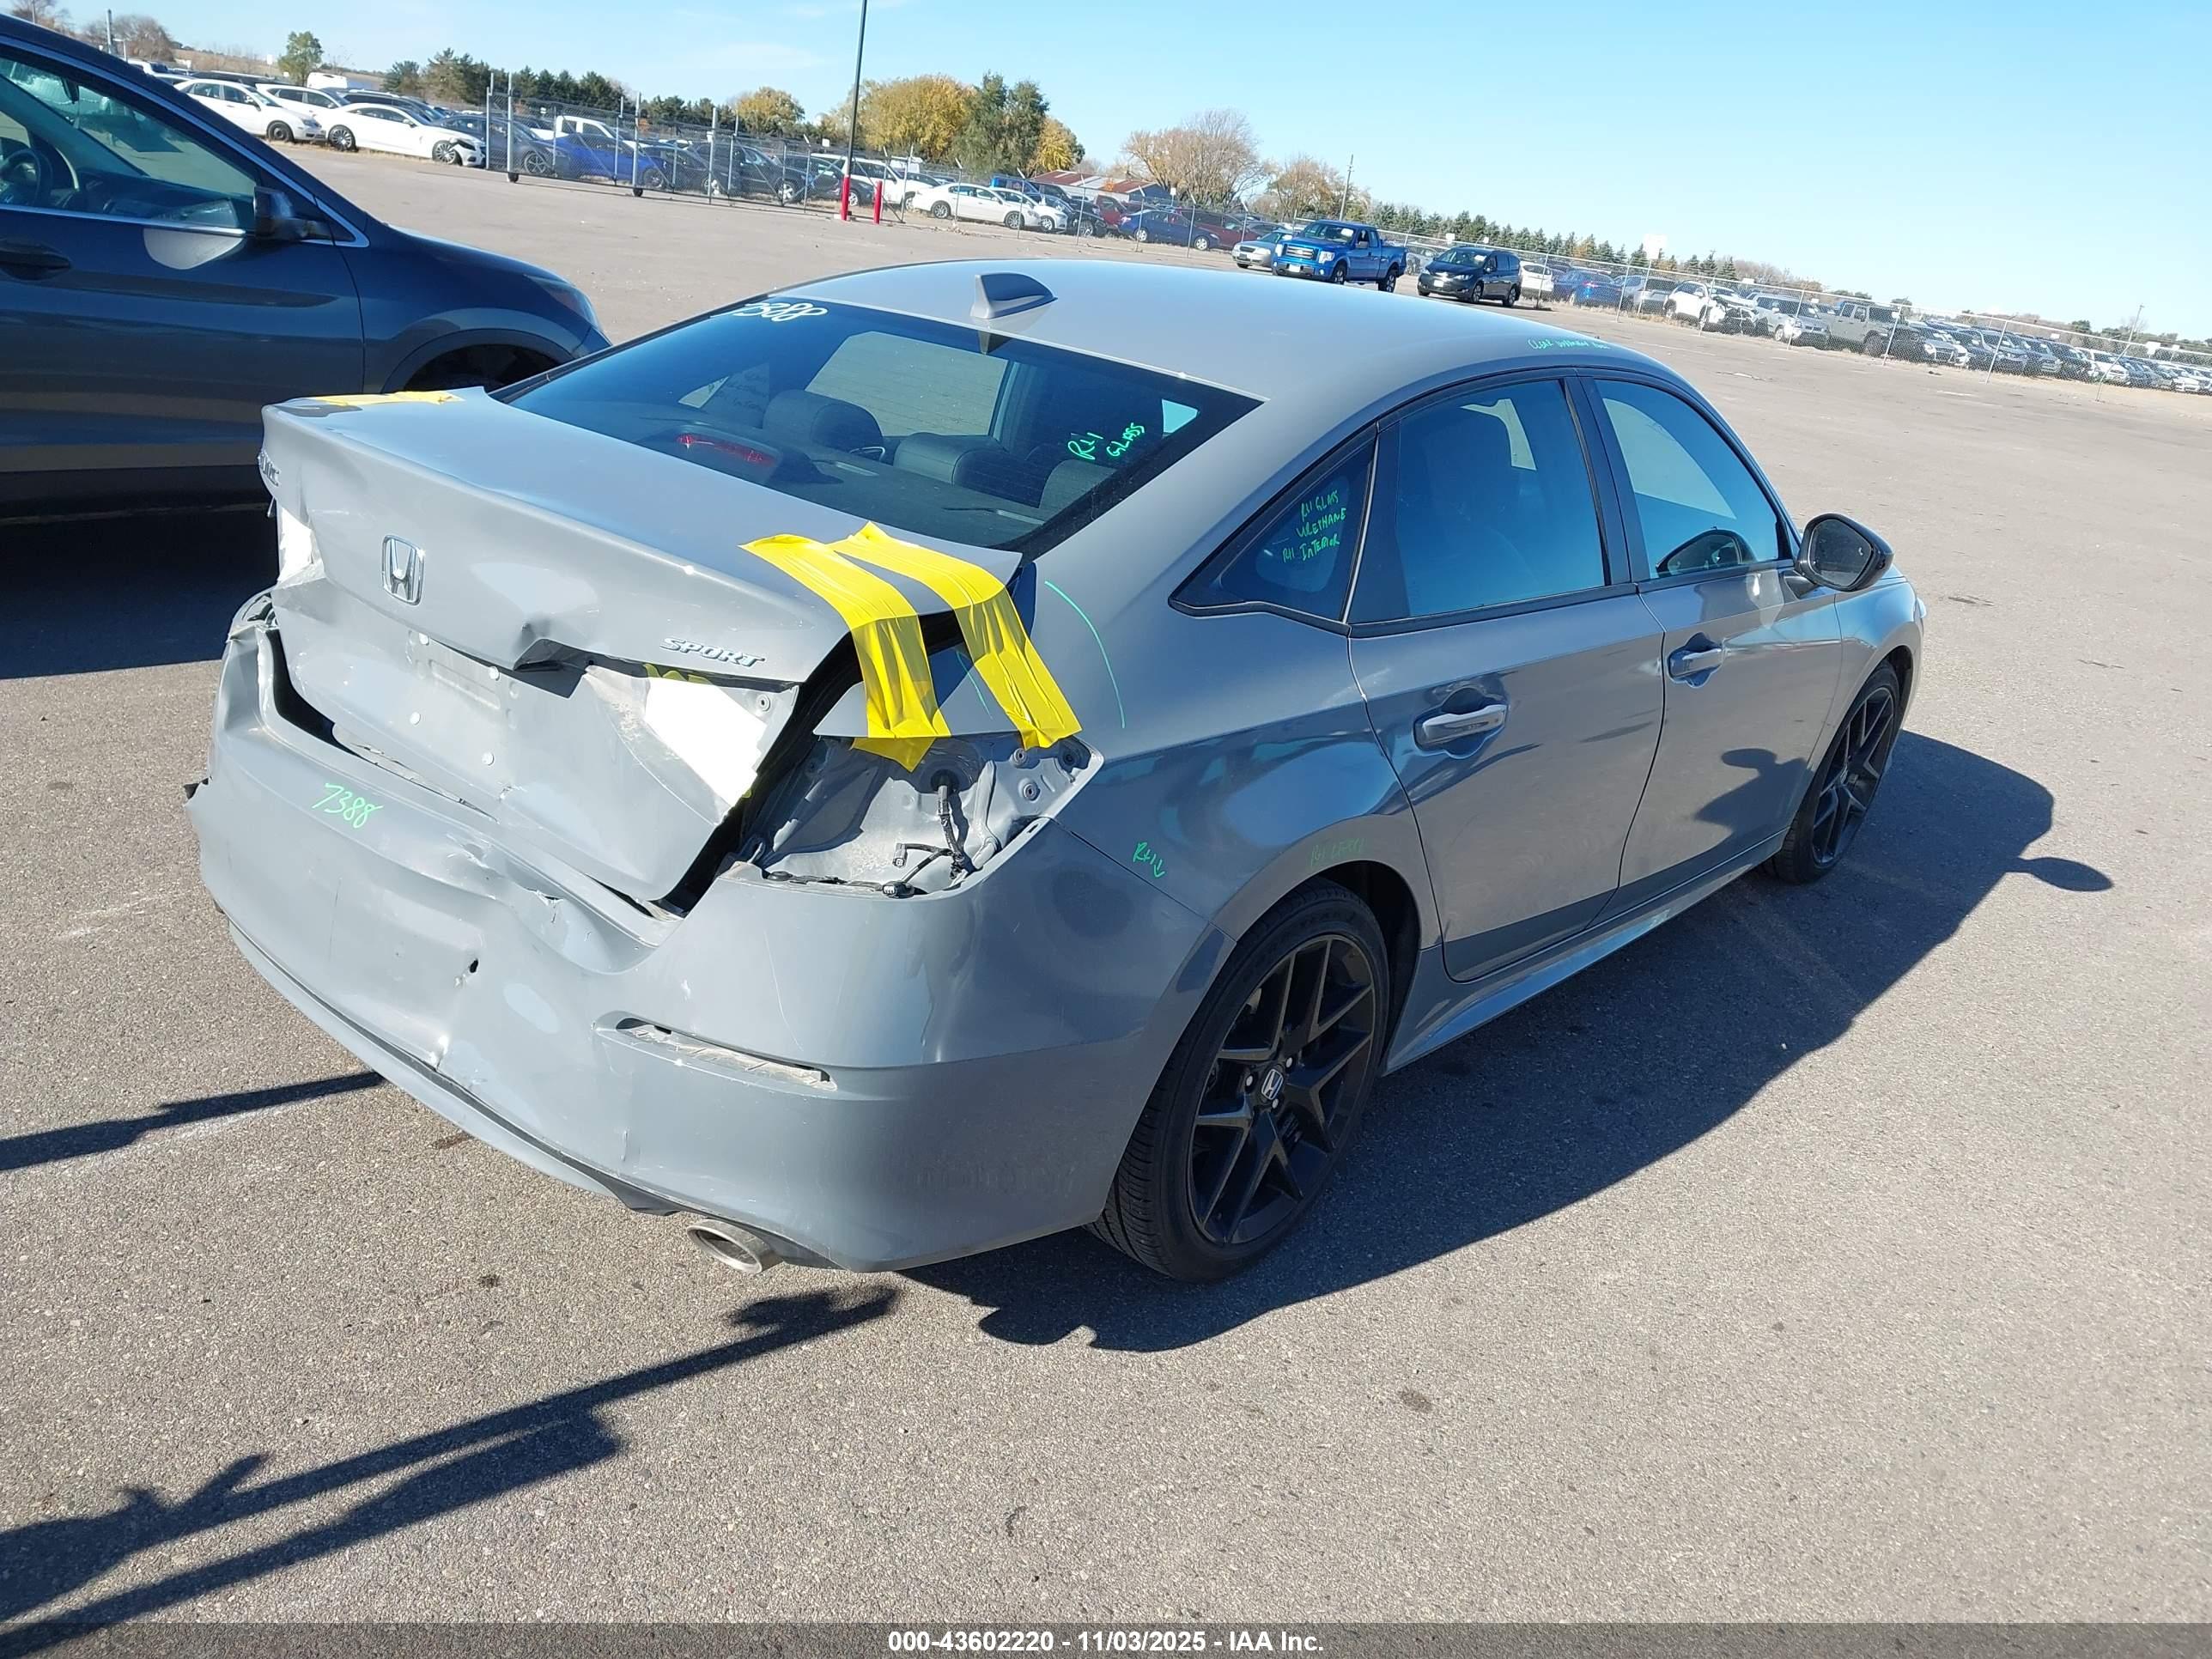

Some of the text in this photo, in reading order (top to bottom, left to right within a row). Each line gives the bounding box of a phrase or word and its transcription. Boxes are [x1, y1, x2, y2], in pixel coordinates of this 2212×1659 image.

[1105, 422, 1145, 457] GLASS
[659, 637, 766, 667] SPORT
[312, 782, 384, 829] 7388
